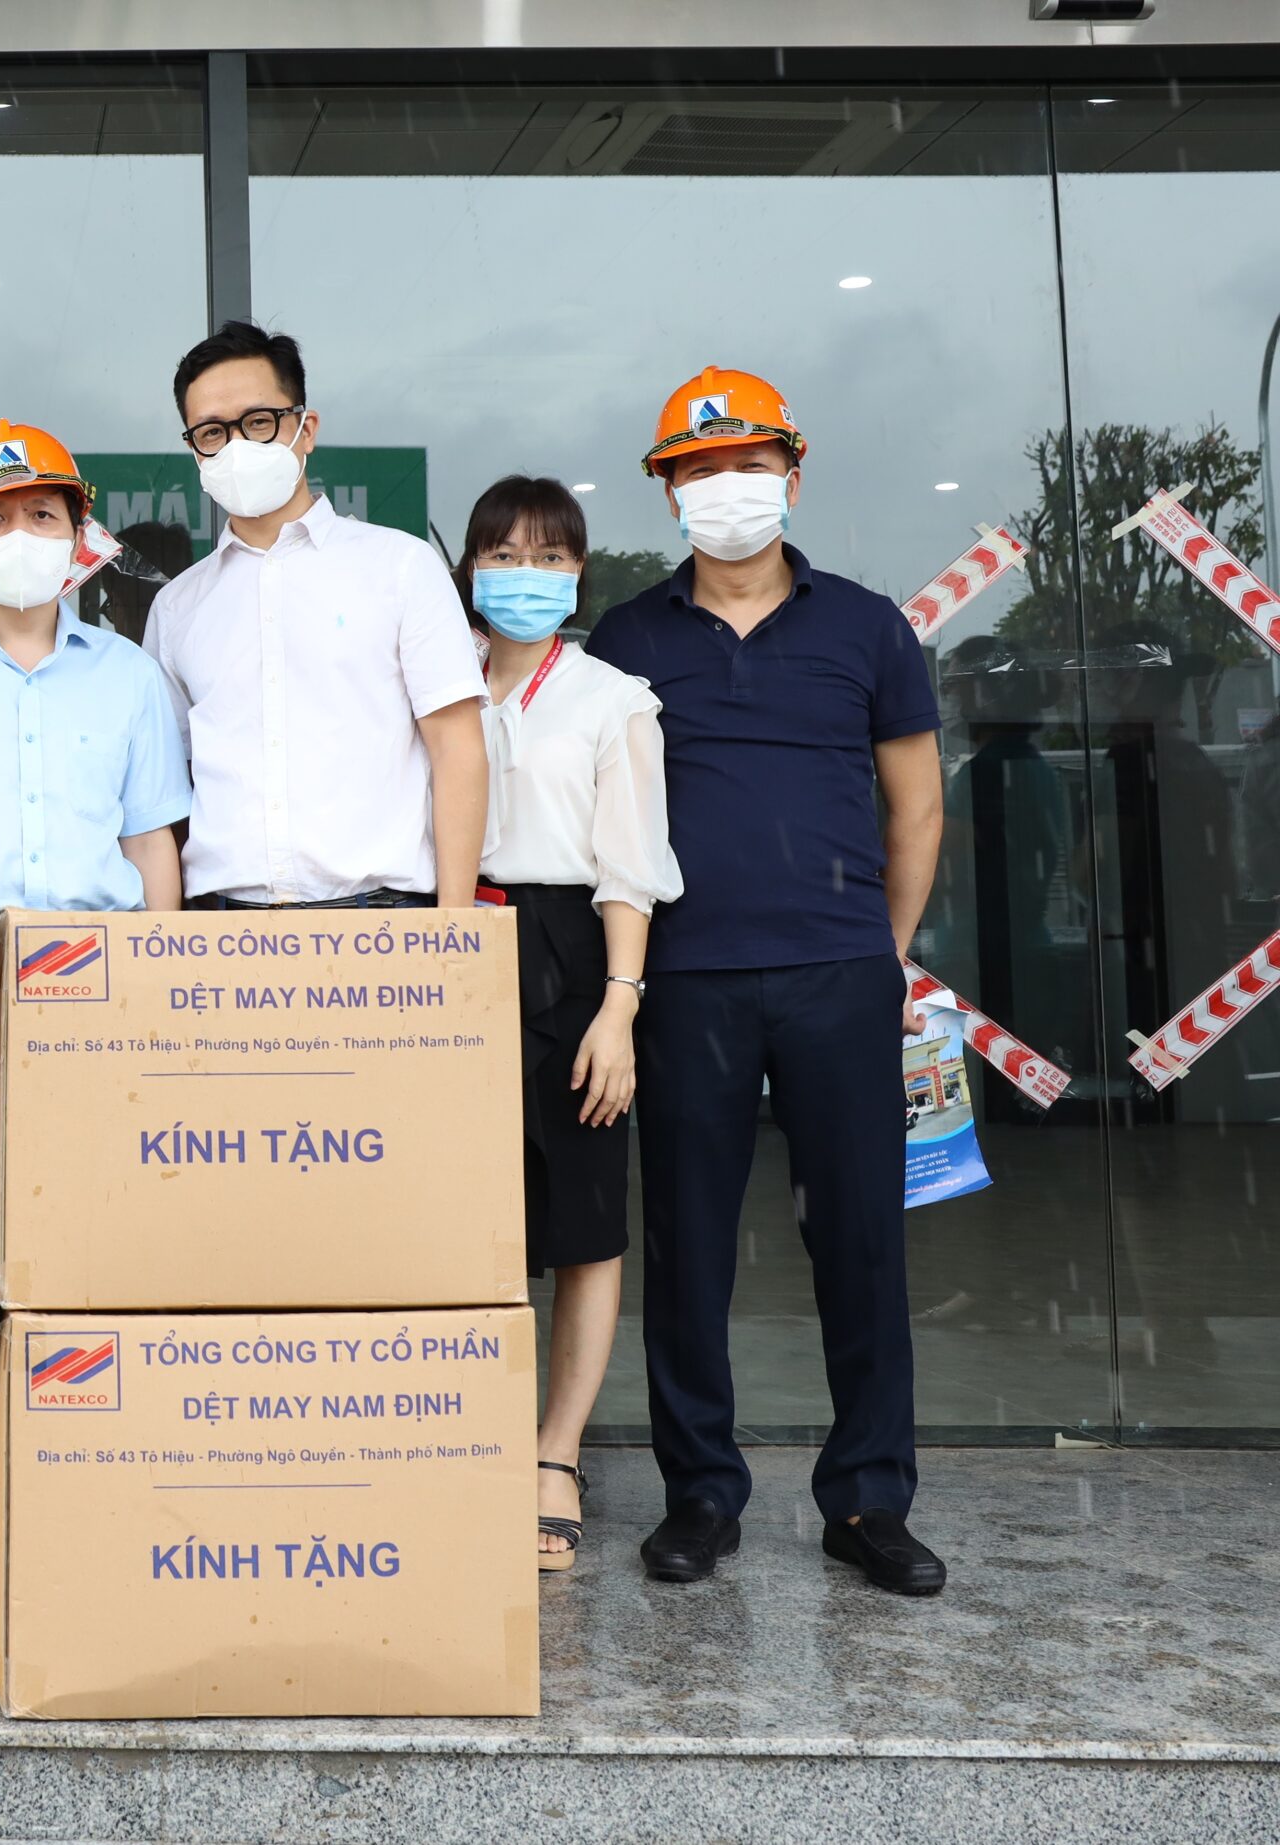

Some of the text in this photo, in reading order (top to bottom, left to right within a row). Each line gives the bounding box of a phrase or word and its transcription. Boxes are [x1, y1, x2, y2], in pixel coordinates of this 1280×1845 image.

[128, 920, 481, 959] TỔNG CÔNG TY CỔ PHẦN
[23, 986, 92, 996] NATEXCO
[169, 982, 445, 1013] DỆT MAY NAM ĐỊNH
[26, 1039, 51, 1055] Địa
[52, 1038, 80, 1054] chỉ:
[84, 1039, 106, 1054] Số
[105, 1040, 125, 1054] 43
[128, 1039, 147, 1055] Tô
[148, 1039, 183, 1054] Hiệu
[193, 1036, 250, 1056] Phường
[252, 1039, 282, 1054] Ngô
[341, 1036, 388, 1050] Thành
[388, 1035, 416, 1051] phố
[418, 1035, 451, 1049] Nam
[451, 1034, 485, 1050] Định
[140, 1121, 384, 1174] KÍNH TẶNG
[139, 1327, 501, 1367] TỔNG CÔNG TY CỔ PHẦN
[39, 1394, 108, 1404] NATEXCO
[182, 1392, 463, 1424] DỆT MAY NAM ĐỊNH
[35, 1447, 62, 1466] Địa
[63, 1449, 92, 1464] chỉ:
[95, 1448, 117, 1465] Số
[117, 1449, 137, 1464] 43
[139, 1448, 159, 1464] Tô
[160, 1450, 196, 1465] Hiệu
[206, 1448, 265, 1466] Phường
[266, 1449, 297, 1466] Ngô
[357, 1446, 404, 1462] Thành
[404, 1442, 435, 1462] phố
[435, 1445, 469, 1460] Nam
[469, 1443, 504, 1457] Định
[151, 1535, 401, 1589] KÍNH TẶNG
